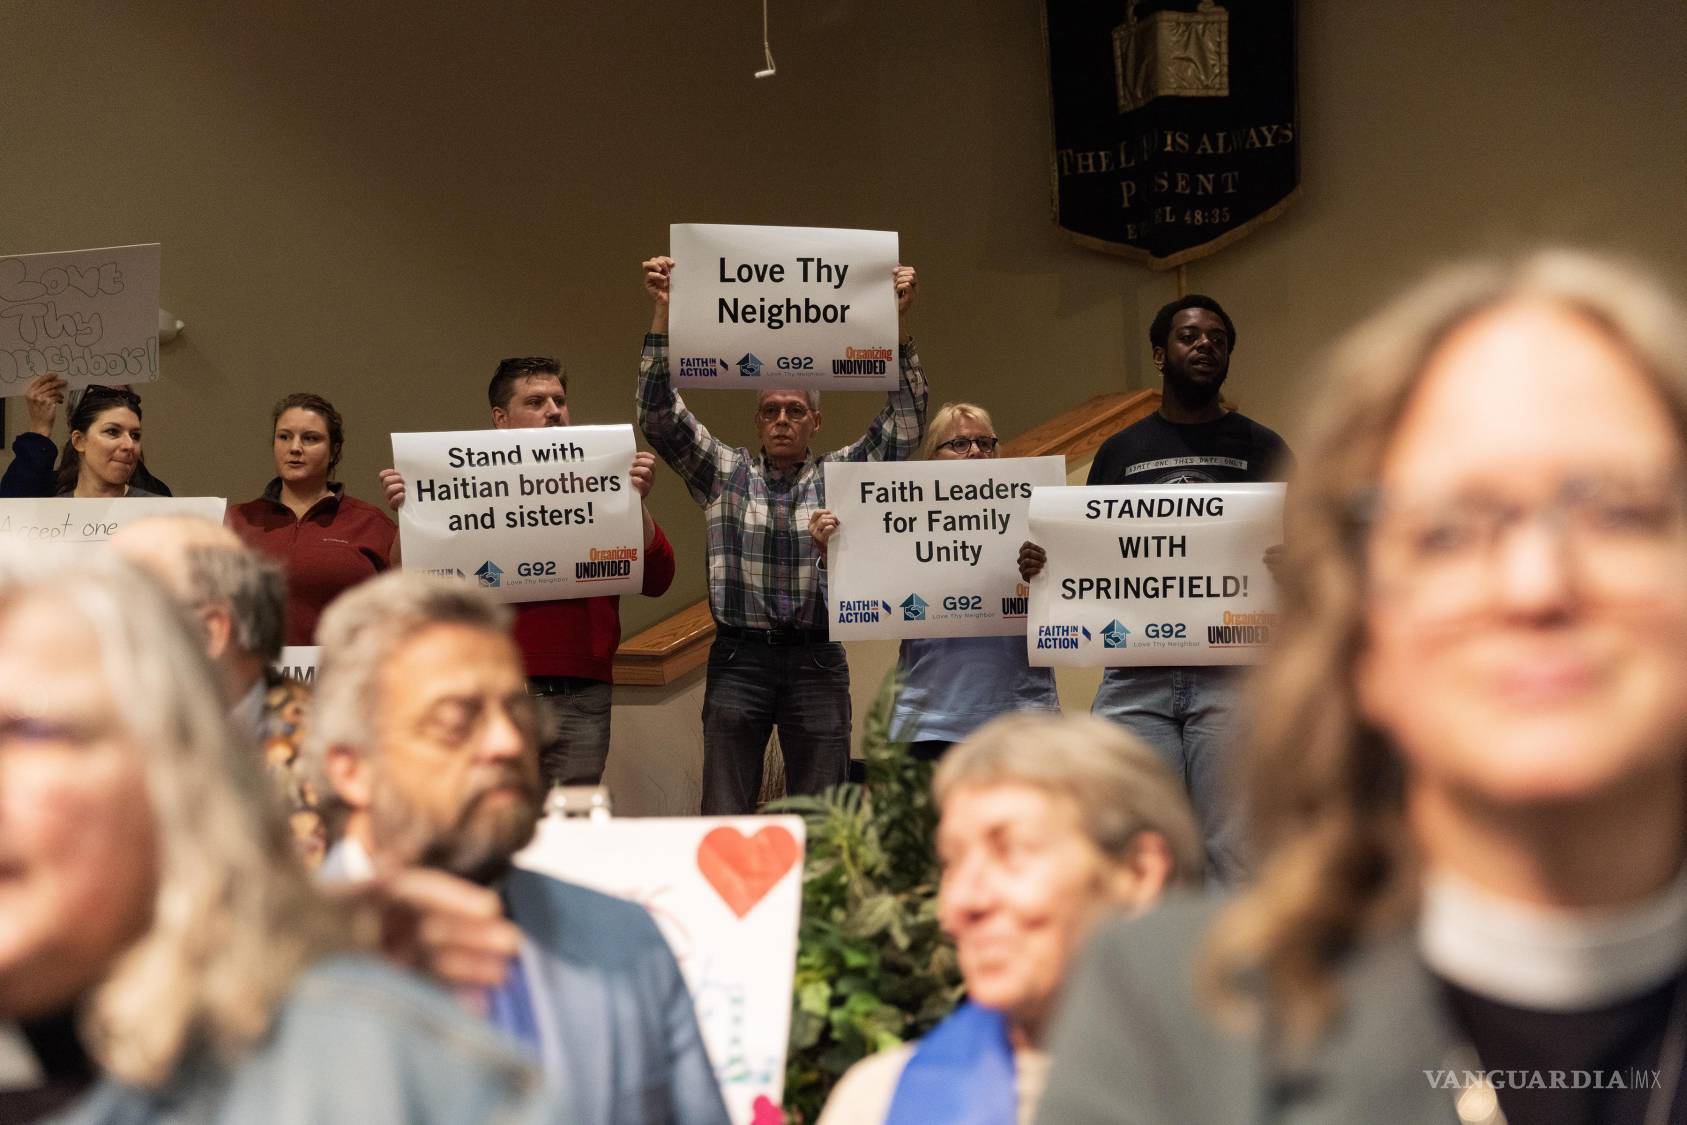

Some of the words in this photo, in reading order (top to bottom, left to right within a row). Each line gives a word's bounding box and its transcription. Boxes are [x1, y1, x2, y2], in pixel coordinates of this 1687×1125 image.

[1057, 147, 1115, 176] THE
[1162, 129, 1191, 153] IS
[1194, 123, 1293, 155] ALWAYS
[1120, 171, 1240, 208] PSENT
[719, 257, 785, 283] Love
[796, 257, 849, 289] Thy
[719, 298, 850, 330] Neighbor
[845, 346, 893, 361] Organizing
[680, 357, 708, 368] FAITH
[709, 358, 716, 366] IN
[776, 356, 814, 369] G92
[832, 359, 886, 375] UNDIVIDED
[679, 367, 718, 377] ACTION
[448, 445, 522, 469] Stand
[532, 442, 584, 465] with
[417, 476, 509, 502] Haitian
[519, 471, 621, 497] brothers
[860, 480, 923, 503] Faith
[934, 478, 1031, 501] Leaders
[449, 507, 495, 531] and
[505, 502, 594, 529] sisters!
[1086, 497, 1224, 519] STANDING
[82, 521, 118, 537] one
[883, 511, 917, 533] for
[927, 508, 1010, 535] Family
[589, 546, 638, 561] Organizing
[915, 541, 982, 566] Unity
[1119, 535, 1186, 558] WITH
[517, 561, 556, 576] G92
[576, 560, 630, 579] UNDIVIDED
[1061, 575, 1249, 600] SPRINGFIELD!
[840, 600, 870, 611] FAITH
[870, 599, 879, 607] IN
[943, 595, 982, 610] G92
[838, 611, 879, 624] ACTION
[1038, 625, 1070, 637] FAITH
[1070, 625, 1078, 633] IN
[1145, 623, 1187, 639] G92
[1037, 637, 1079, 649] ACTION
